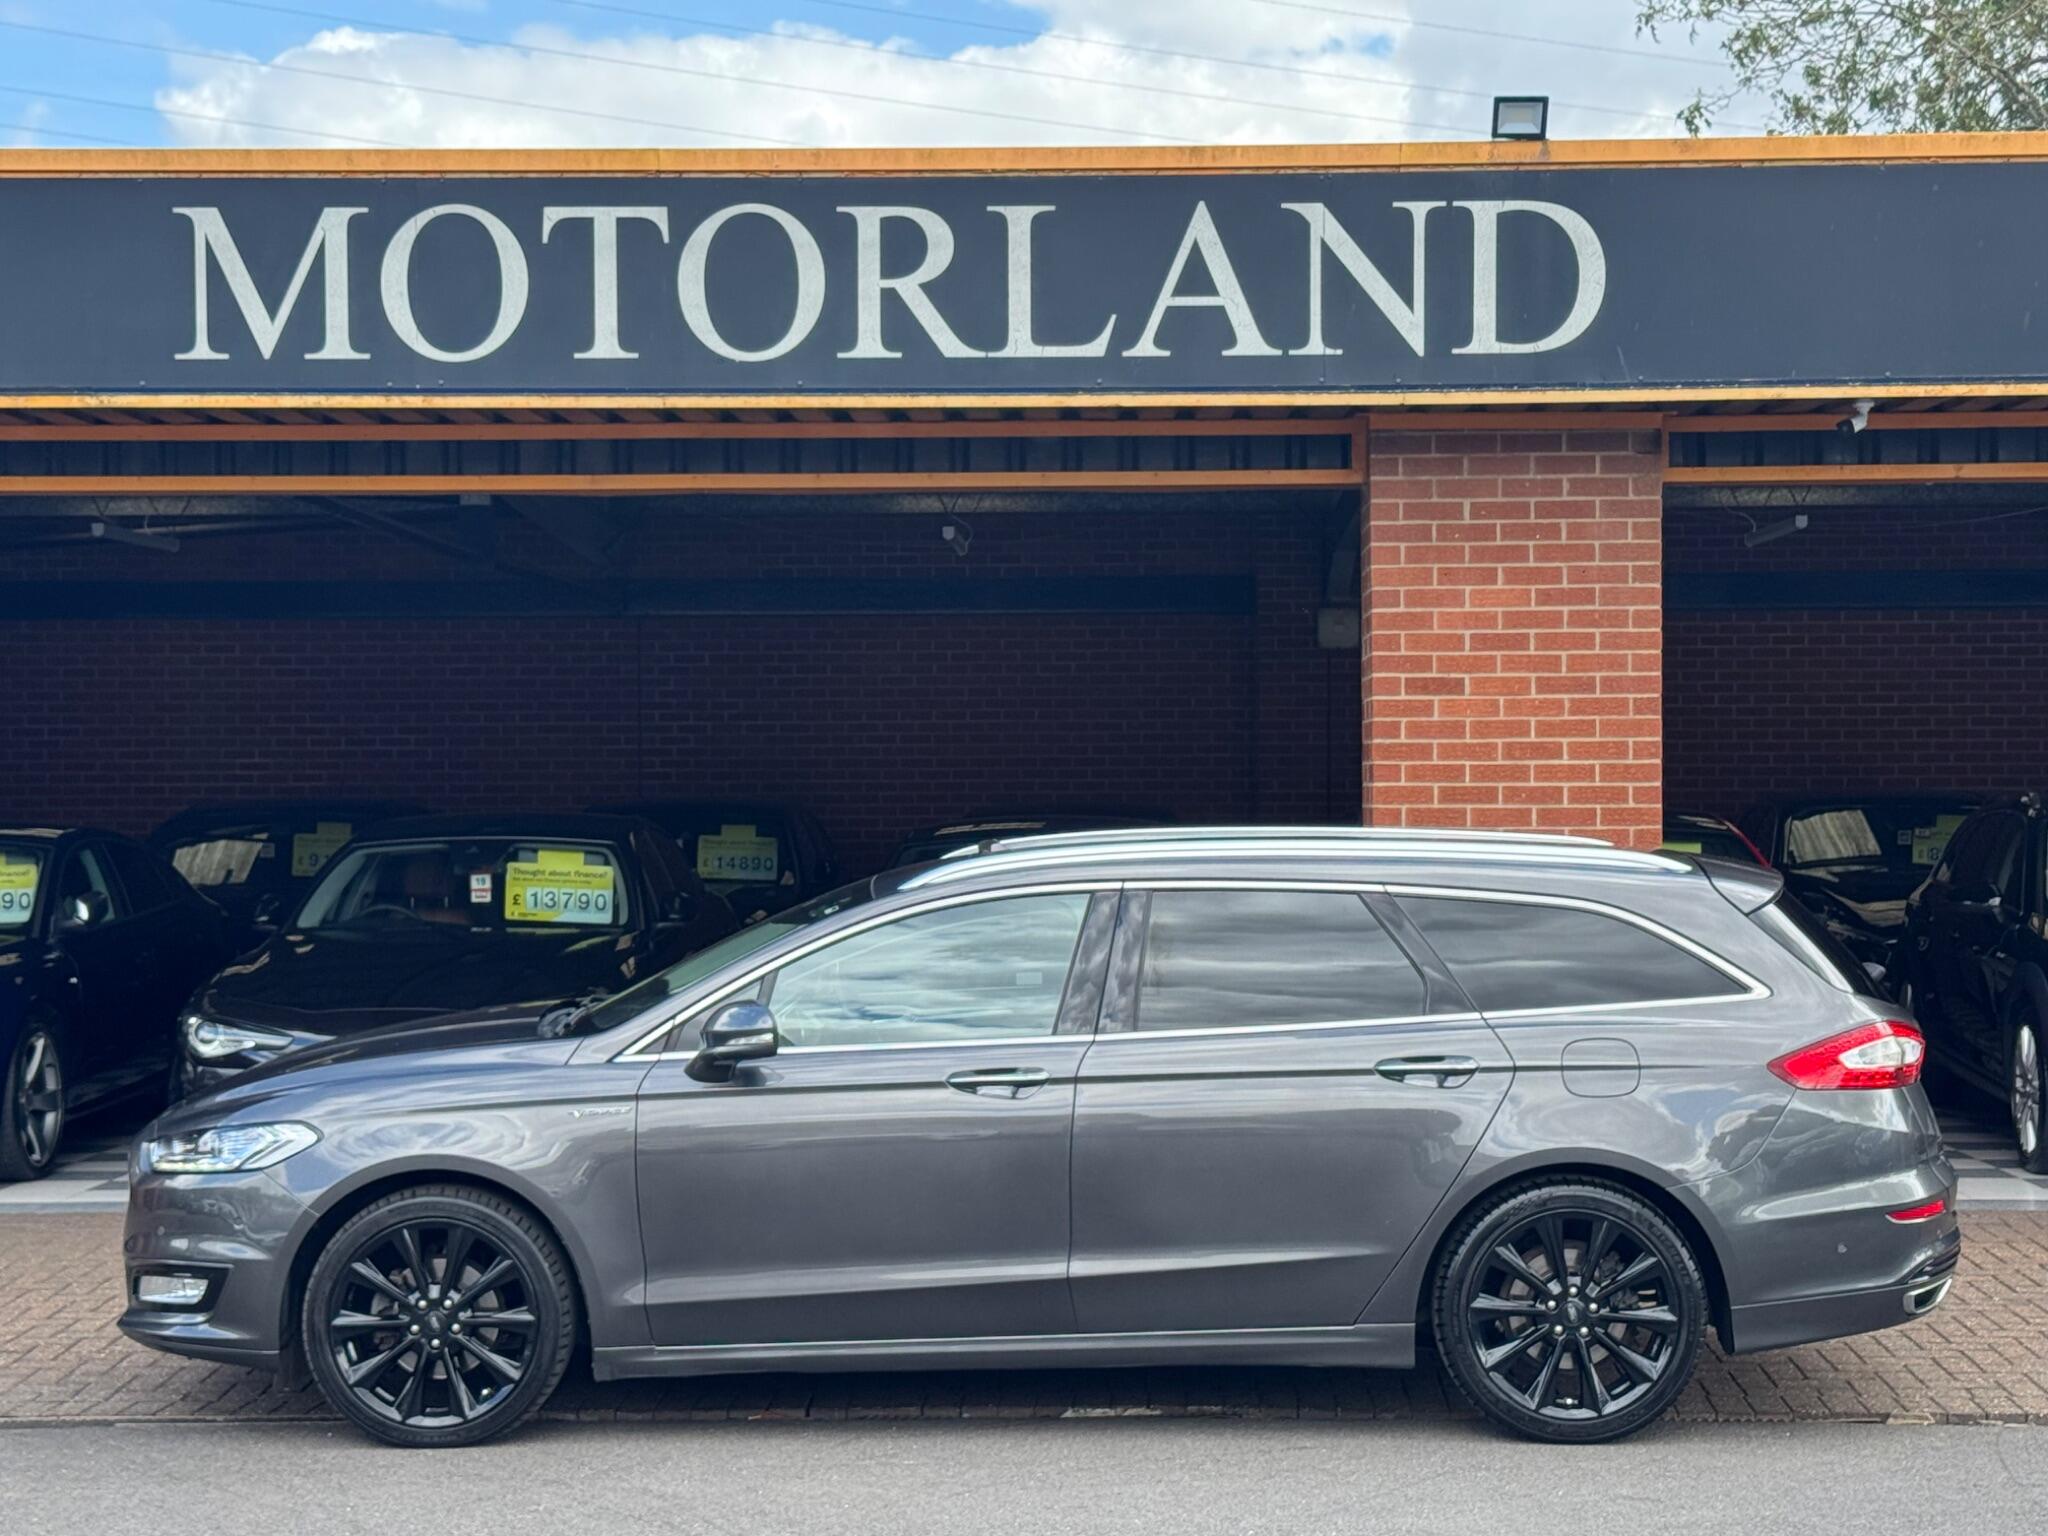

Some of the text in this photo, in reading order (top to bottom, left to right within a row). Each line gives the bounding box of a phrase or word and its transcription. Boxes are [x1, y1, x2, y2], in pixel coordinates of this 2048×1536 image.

[172, 200, 1607, 363] MOTORLAND
[717, 856, 774, 871] 14890
[512, 891, 607, 911] £ 13790
